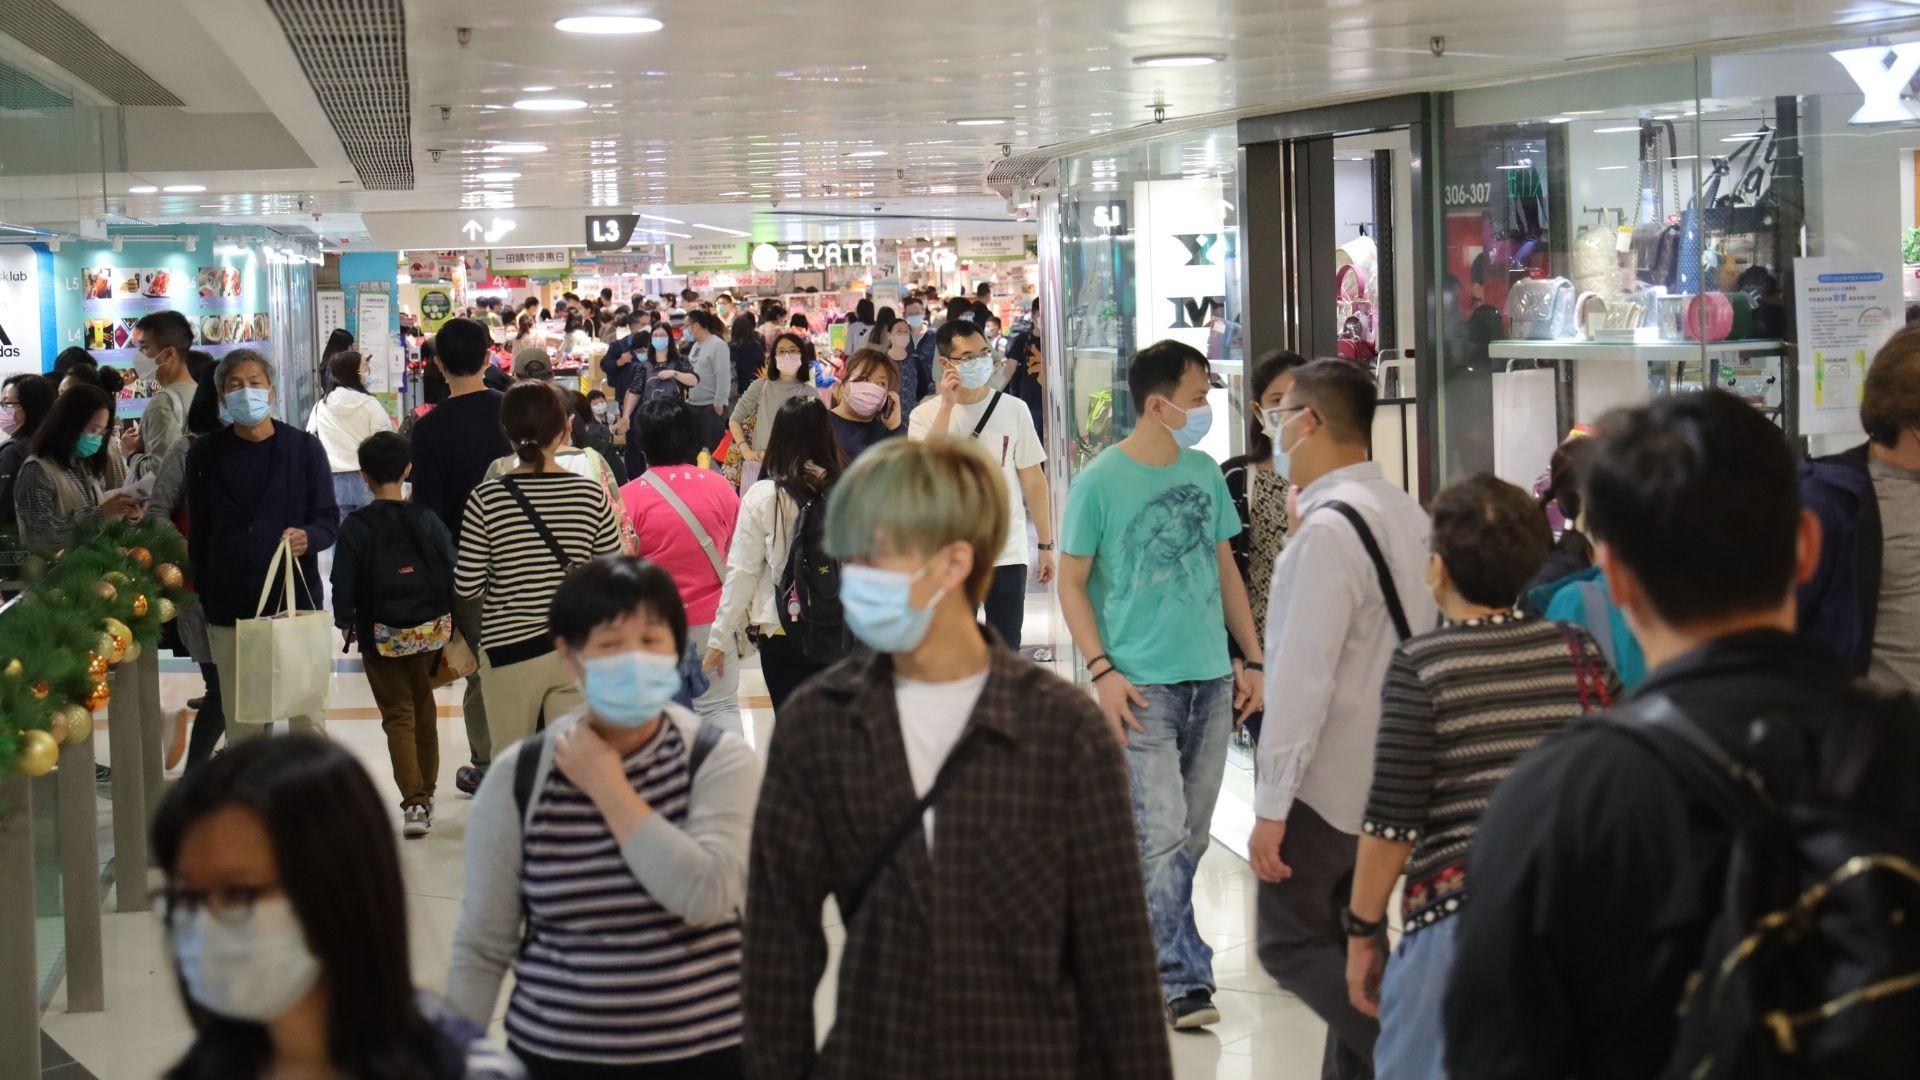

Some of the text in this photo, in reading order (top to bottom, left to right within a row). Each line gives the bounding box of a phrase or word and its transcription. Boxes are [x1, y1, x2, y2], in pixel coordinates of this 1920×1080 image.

[1828, 42, 1920, 123] Y
[1445, 183, 1491, 205] 306-307
[593, 220, 619, 242] L3
[807, 243, 877, 268] YATA
[1171, 233, 1217, 266] Y
[0, 270, 27, 281] klab
[65, 277, 80, 291] L5
[1166, 295, 1225, 328] M
[67, 328, 82, 342] L4
